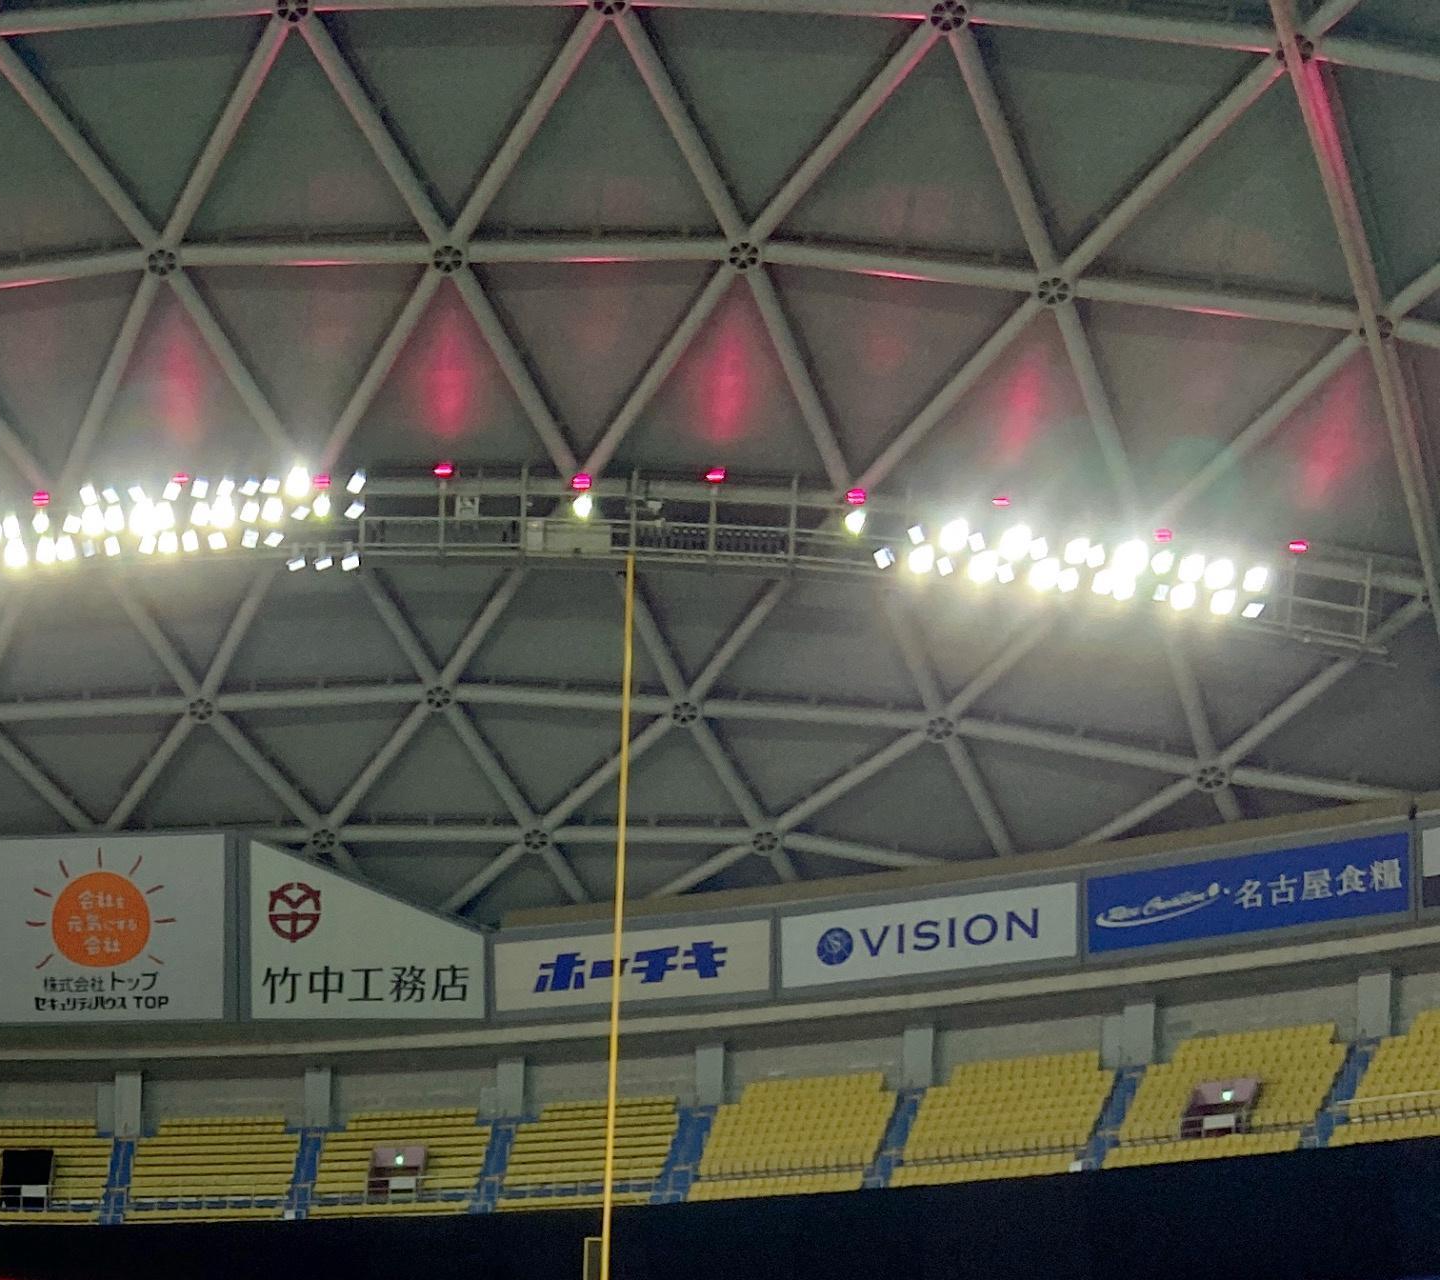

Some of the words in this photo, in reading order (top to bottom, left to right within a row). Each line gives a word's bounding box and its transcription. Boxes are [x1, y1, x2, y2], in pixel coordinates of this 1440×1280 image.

[1233, 858, 1403, 909] 名古屋食糧
[84, 935, 121, 956] 会社
[860, 907, 1040, 958] VISION
[260, 964, 470, 1005] 竹中工務店
[533, 941, 729, 993] ホーチキ
[133, 995, 170, 1010] TOP
